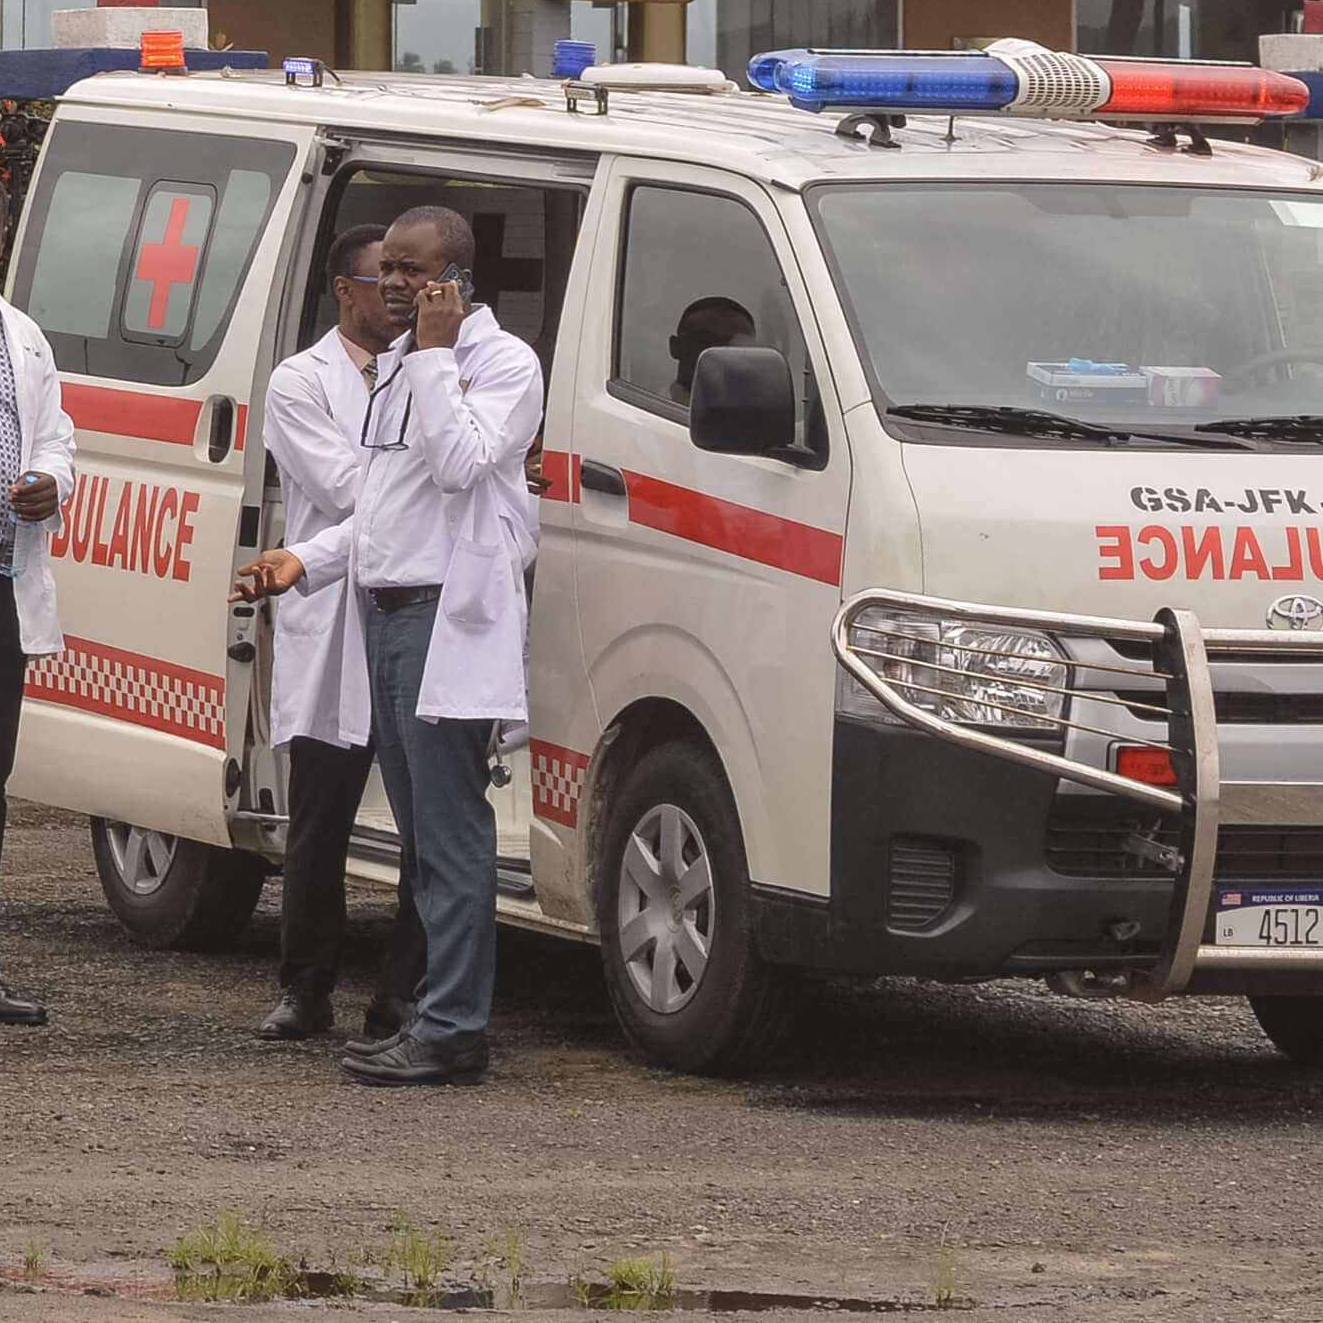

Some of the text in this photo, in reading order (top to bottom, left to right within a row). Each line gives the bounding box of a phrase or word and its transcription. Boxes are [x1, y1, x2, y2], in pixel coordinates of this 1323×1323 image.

[1130, 486, 1323, 515] GSA-JFK
[47, 473, 200, 582] BULANCE
[1252, 894, 1283, 902] REPUBLIC
[1284, 894, 1293, 902] OF
[1223, 927, 1234, 937] LB
[1259, 908, 1319, 945] 4512
